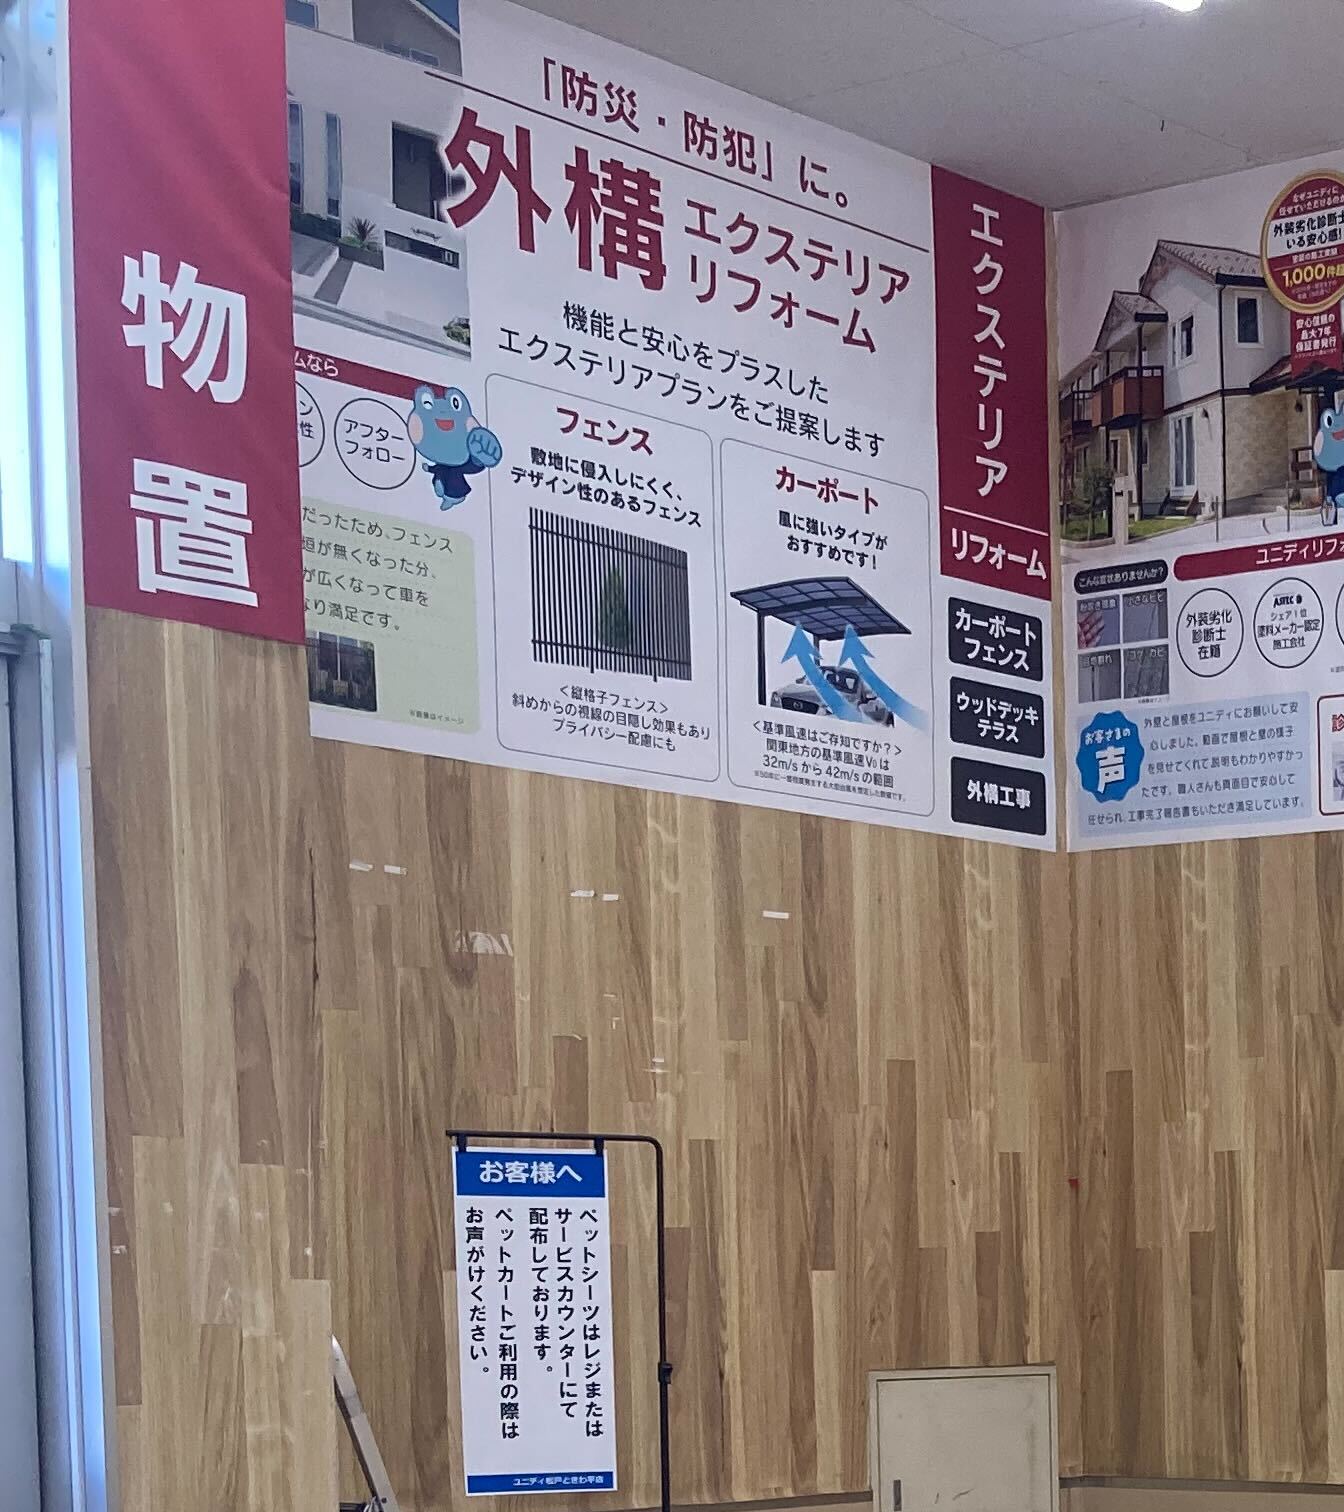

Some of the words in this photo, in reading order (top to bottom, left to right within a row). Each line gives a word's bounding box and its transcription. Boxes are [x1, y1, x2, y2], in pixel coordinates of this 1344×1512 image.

[541, 56, 850, 211] 「防災・防犯」に。
[442, 106, 668, 291] 外構
[685, 199, 912, 304] エクステリア
[689, 255, 877, 355] リフォーム
[562, 300, 830, 405] 機能と安心をプラスした
[967, 202, 1010, 498] エクステリア
[498, 326, 886, 457] エクステリアプランをご提案します
[120, 251, 258, 608] 物置
[342, 418, 406, 443] アフター
[345, 440, 406, 464] フォロー
[556, 405, 655, 456] フェンス
[511, 467, 703, 528] デザイン性のあるフェンス
[529, 447, 683, 503] 敷地に侵入しにくく、
[775, 465, 880, 515] カーポート
[778, 510, 889, 552] 風に強いタイプが
[950, 526, 1049, 581] リフォーム
[954, 606, 1038, 648] カーポート
[1185, 609, 1233, 631] 外装劣化
[1191, 627, 1228, 645] 診断士
[964, 636, 1031, 673] フェンス
[511, 692, 711, 741] 斜めからの視線の目隠し効果もあり
[956, 690, 1040, 727] ウッドデッキ
[977, 716, 1020, 745] テラス
[552, 717, 678, 753] プライバシー配慮にも
[762, 753, 799, 773] 32m/s
[802, 762, 823, 776] から
[825, 766, 860, 782] 42m/s
[862, 773, 894, 789] の範囲
[966, 778, 1033, 810] 外構工事
[1095, 746, 1128, 795] 声
[478, 1160, 583, 1186] お客様へ
[464, 1205, 491, 1375] お声がけください。
[527, 1206, 555, 1374] 配布しております。
[553, 1206, 579, 1420] サービスカウンターにて
[495, 1206, 520, 1440] ペットカートご利用の際は
[579, 1206, 605, 1439] ペットシーツはレジまたは
